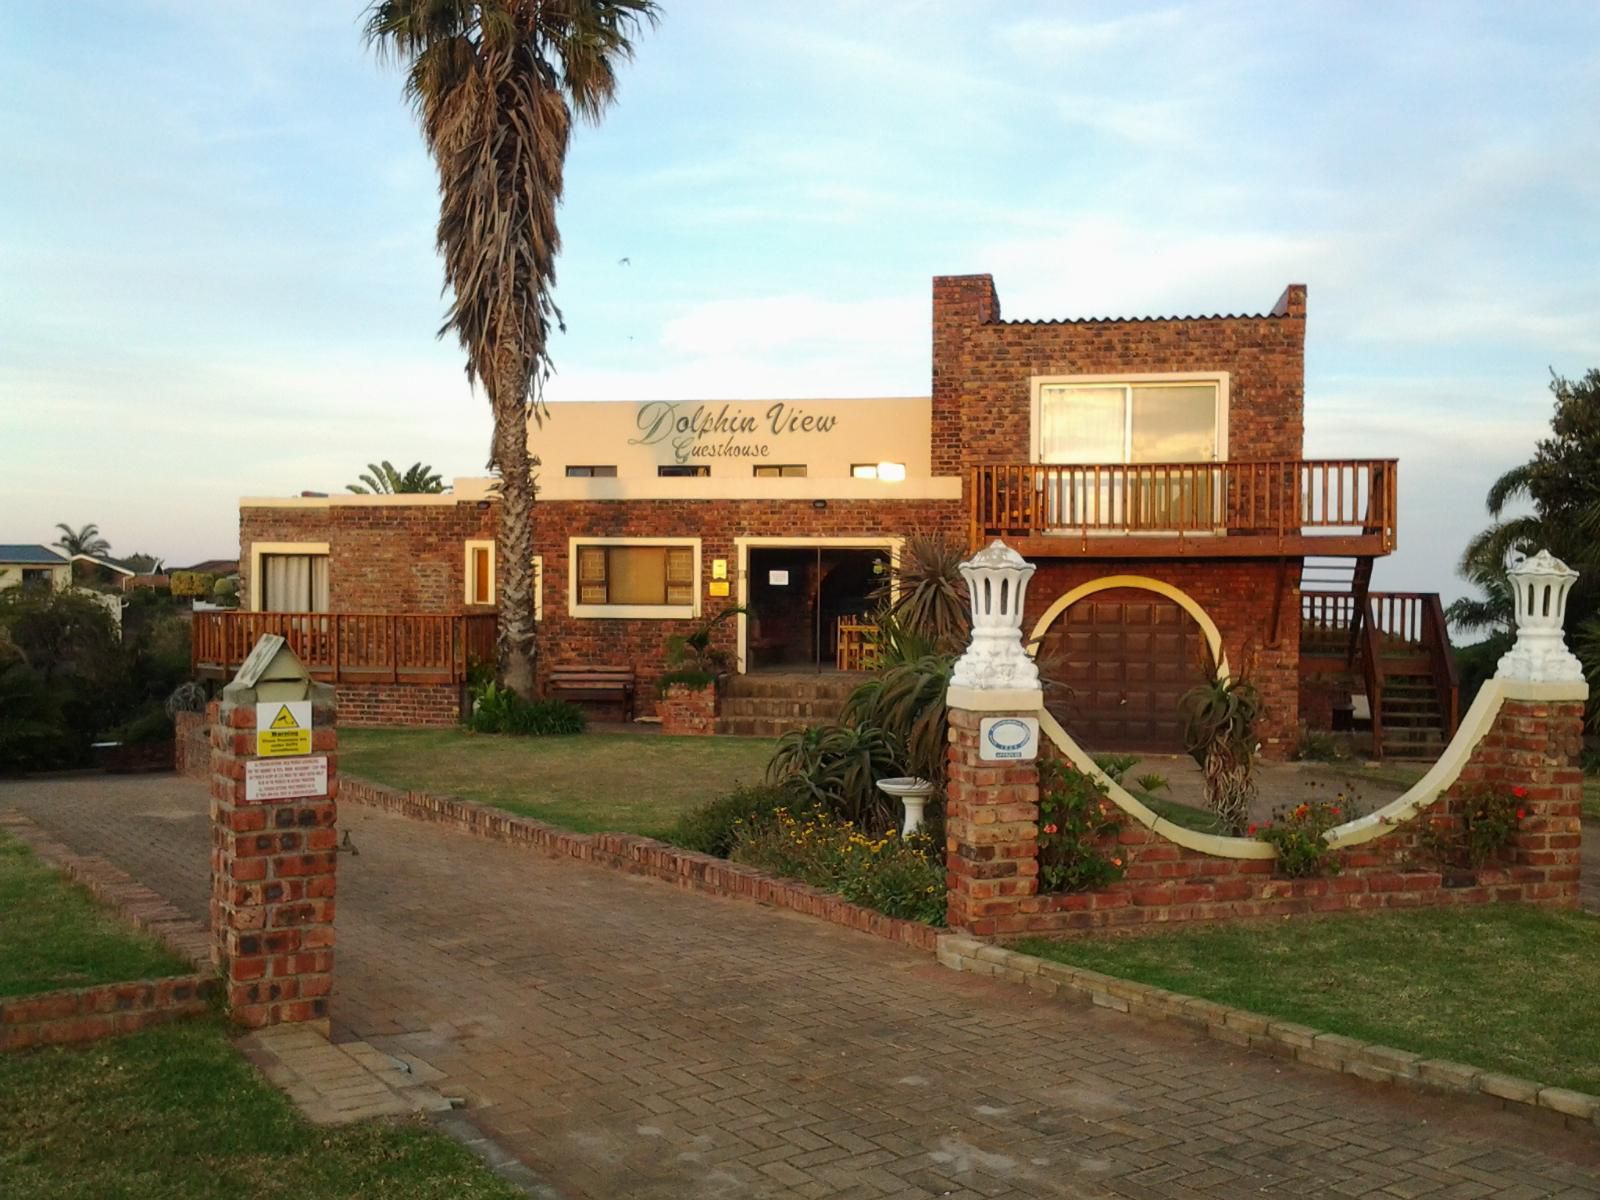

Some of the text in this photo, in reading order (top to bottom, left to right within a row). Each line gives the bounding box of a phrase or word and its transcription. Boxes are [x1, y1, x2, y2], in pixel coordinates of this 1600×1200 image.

[627, 401, 838, 445] Dolphin View
[671, 436, 770, 464] Guesthouse
